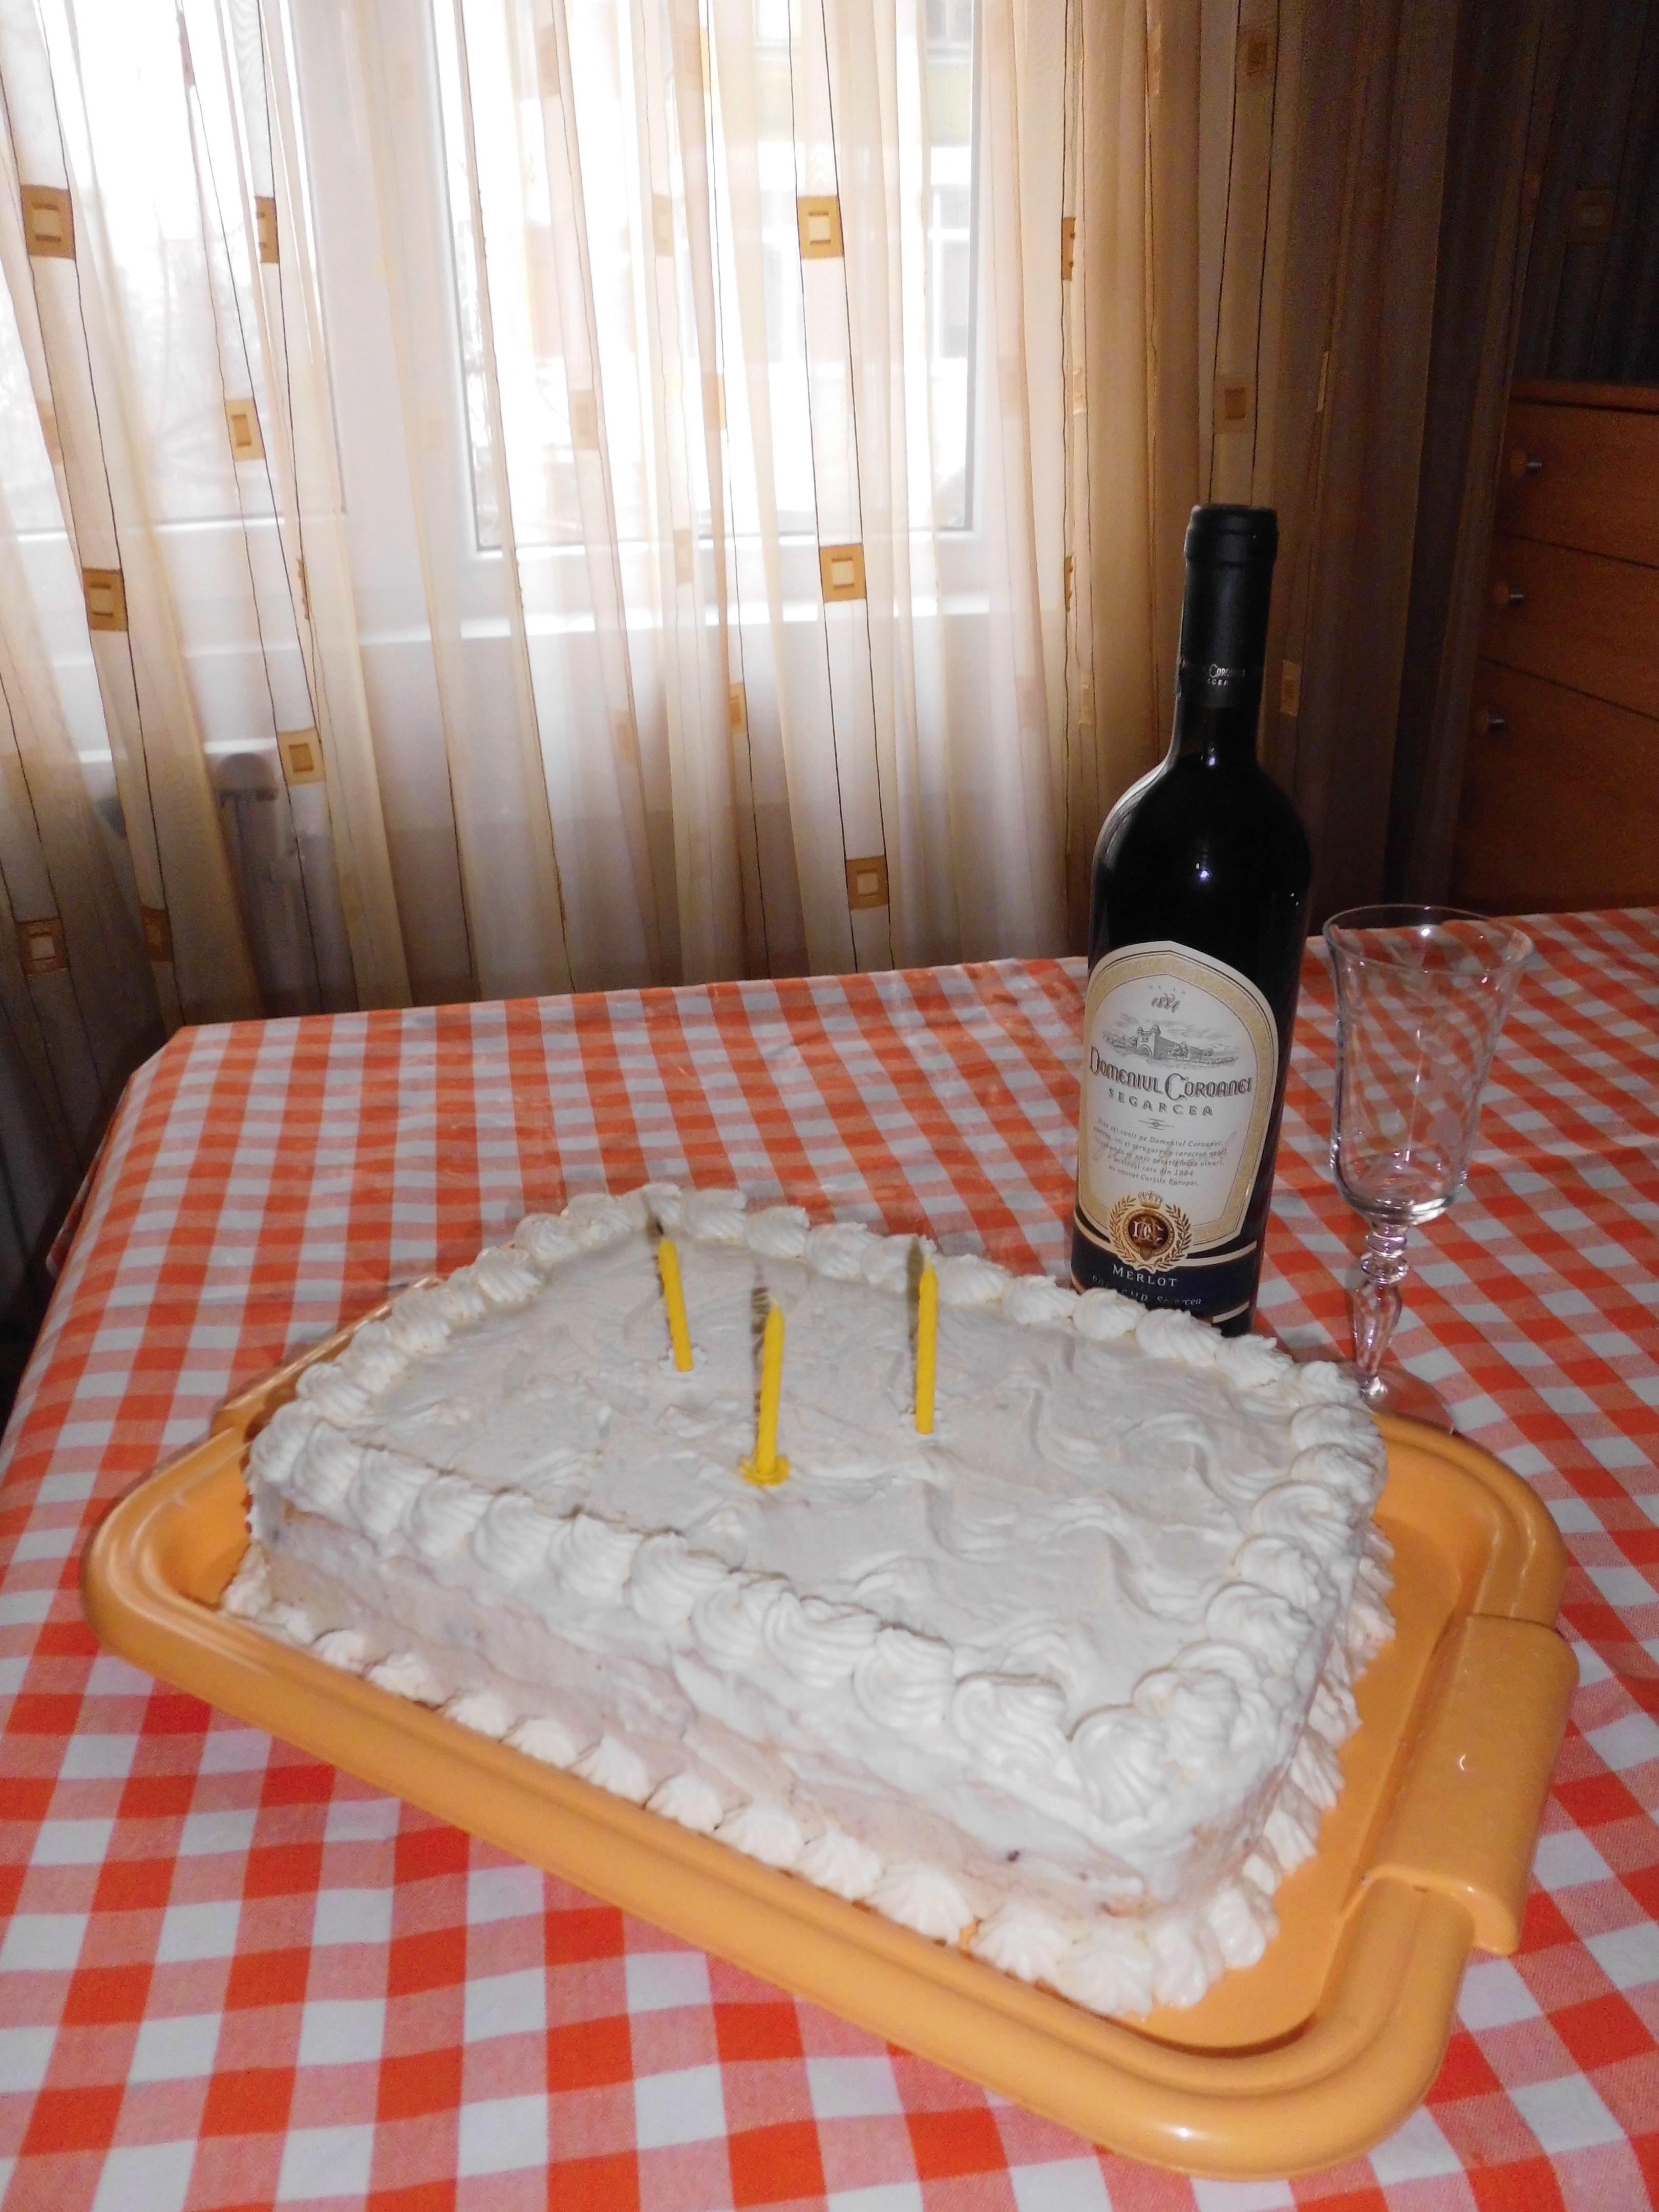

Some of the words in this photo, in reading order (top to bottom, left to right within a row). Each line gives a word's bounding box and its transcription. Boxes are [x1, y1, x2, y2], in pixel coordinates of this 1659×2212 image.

[1109, 1088, 1213, 1116] SEGARCEA
[1150, 1136, 1186, 1146] Domeniul
[1113, 1264, 1177, 1287] MERLOT
